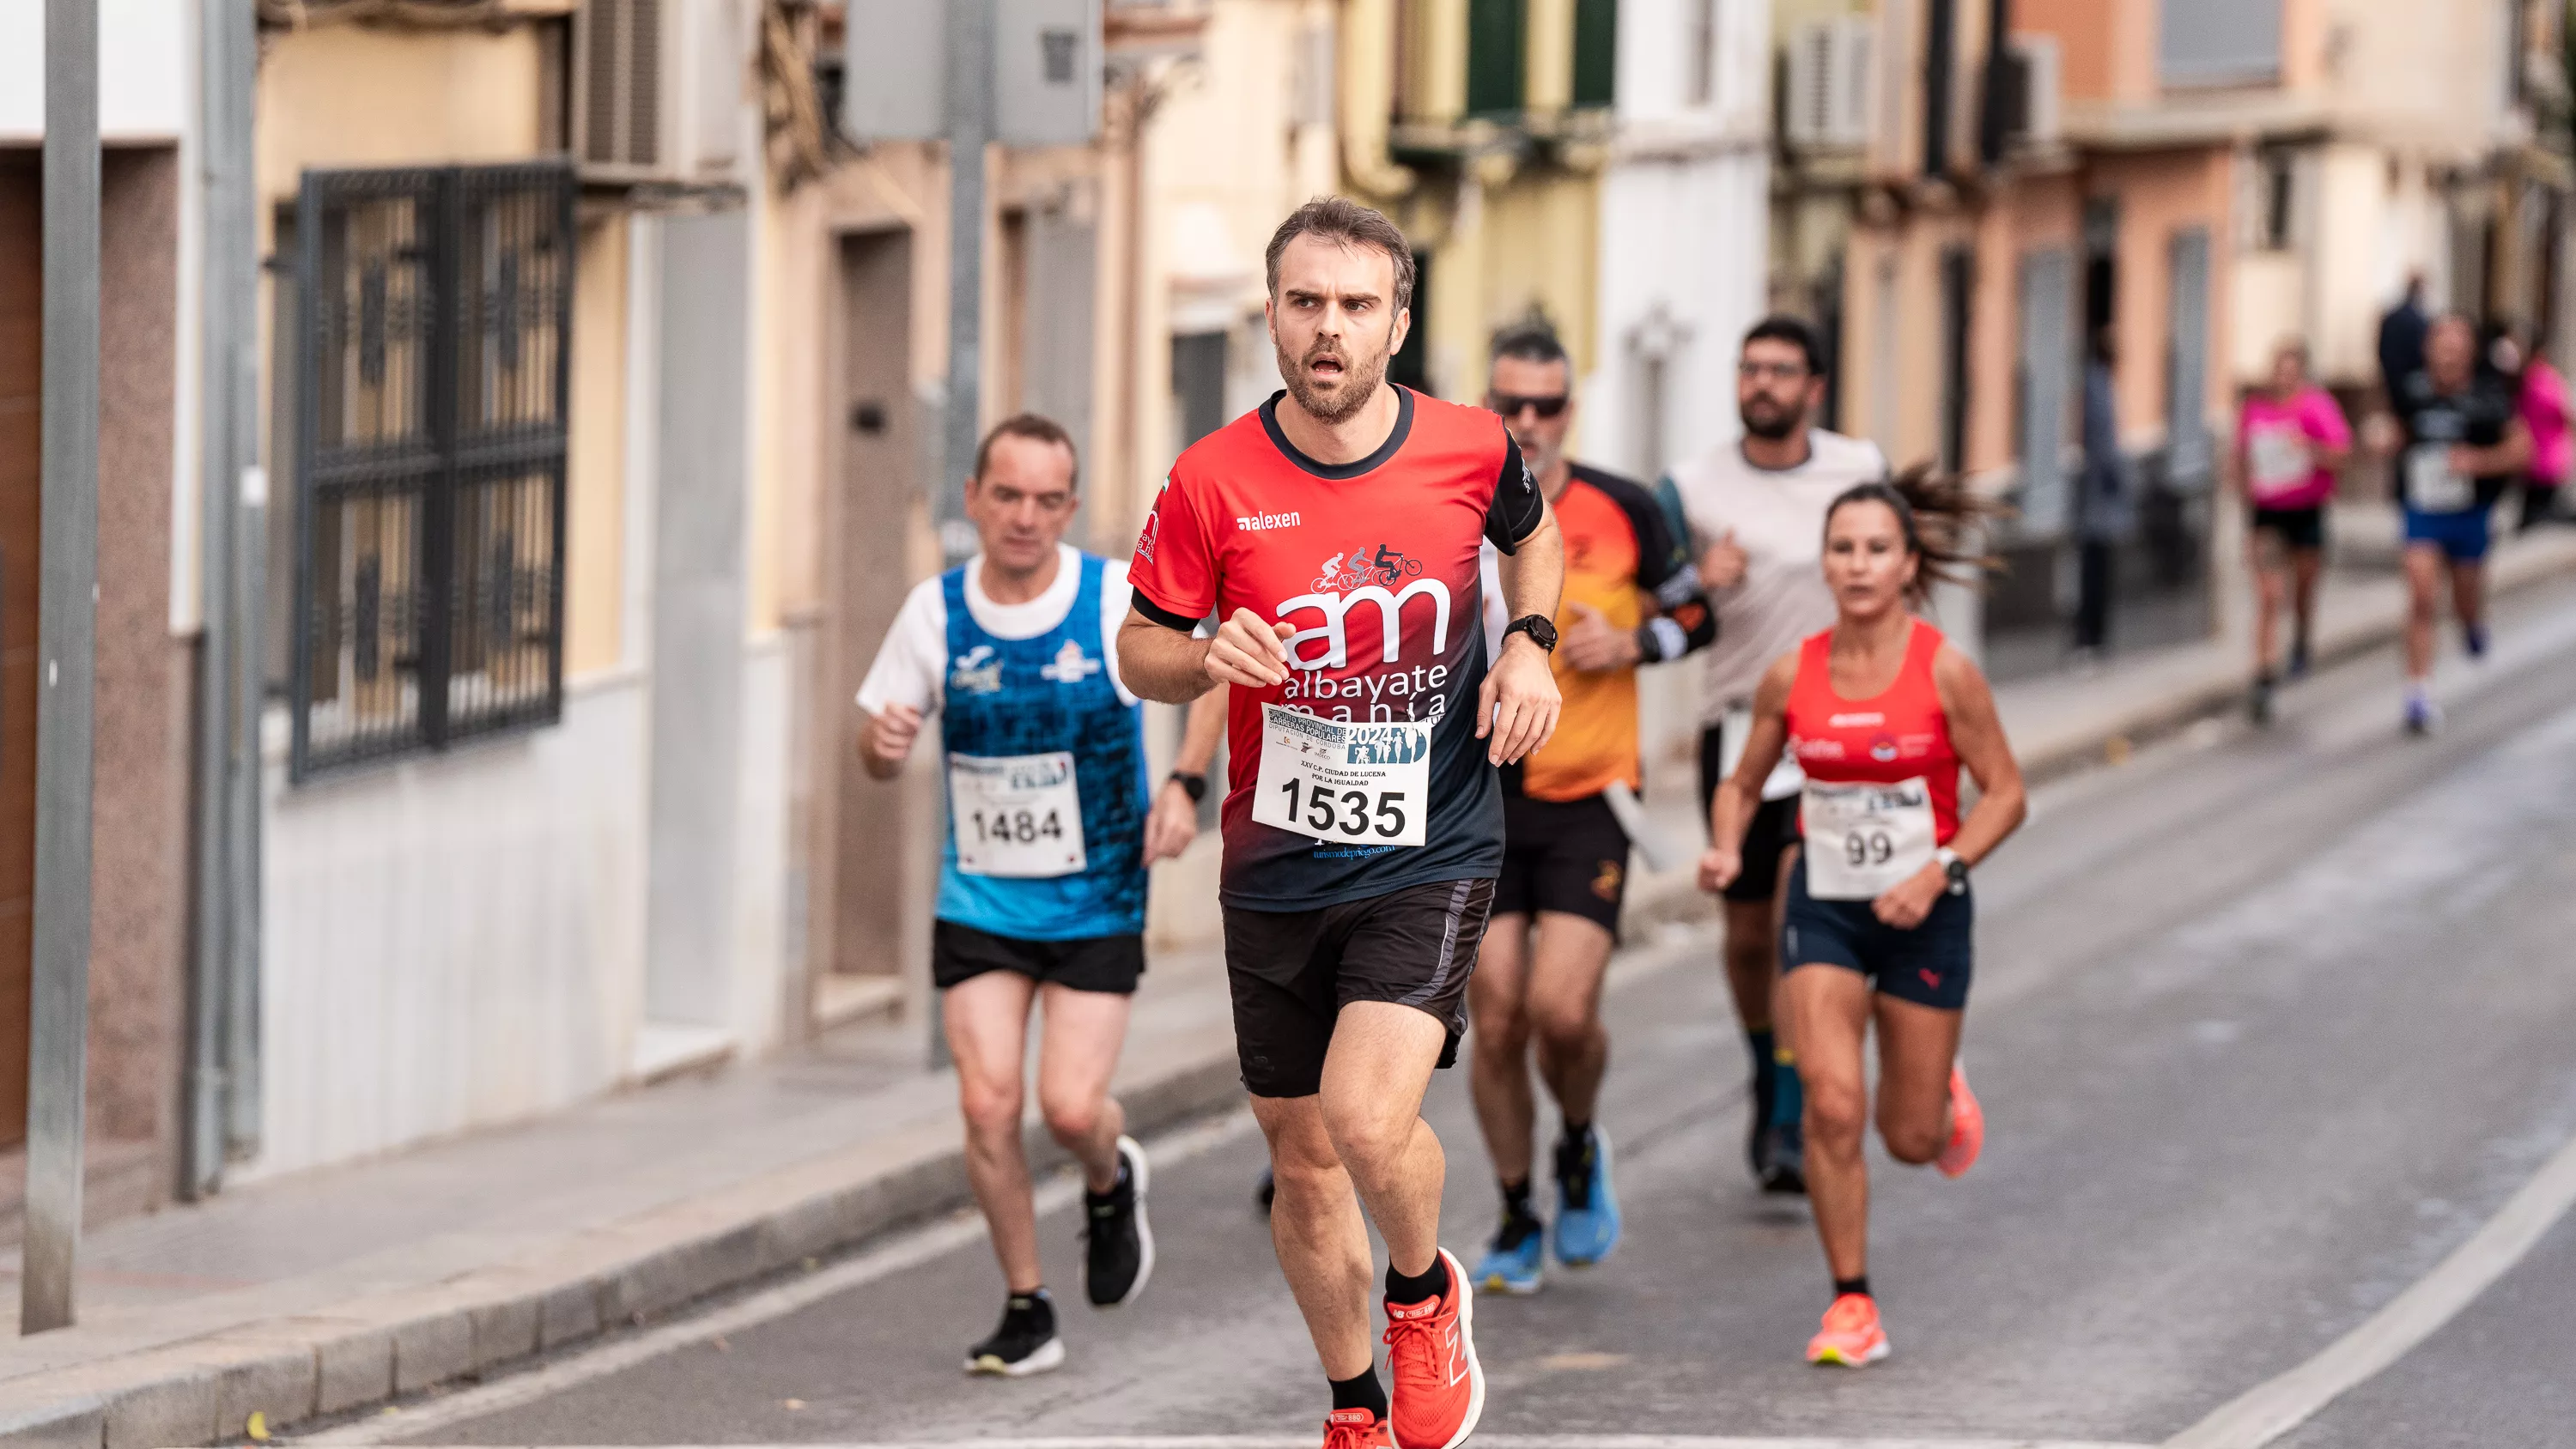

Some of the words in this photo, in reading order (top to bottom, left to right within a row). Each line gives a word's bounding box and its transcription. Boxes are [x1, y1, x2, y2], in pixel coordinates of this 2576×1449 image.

[1251, 511, 1301, 530] alexen
[1276, 578, 1451, 670] am
[1284, 664, 1448, 703] albayate
[1268, 708, 1297, 723] CIRCUITO
[1297, 718, 1334, 734] PROVINCIAL
[1268, 714, 1304, 732] CARRERAS
[1306, 726, 1346, 743] POPULARES
[1348, 727, 1393, 745] 2024
[1313, 764, 1323, 773] C.P.
[1325, 768, 1349, 777] CIUDAD
[1282, 777, 1406, 838] 1535
[972, 809, 1062, 843] 1484
[1314, 845, 1395, 859] turismodepriego.com
[1846, 831, 1893, 867] 99
